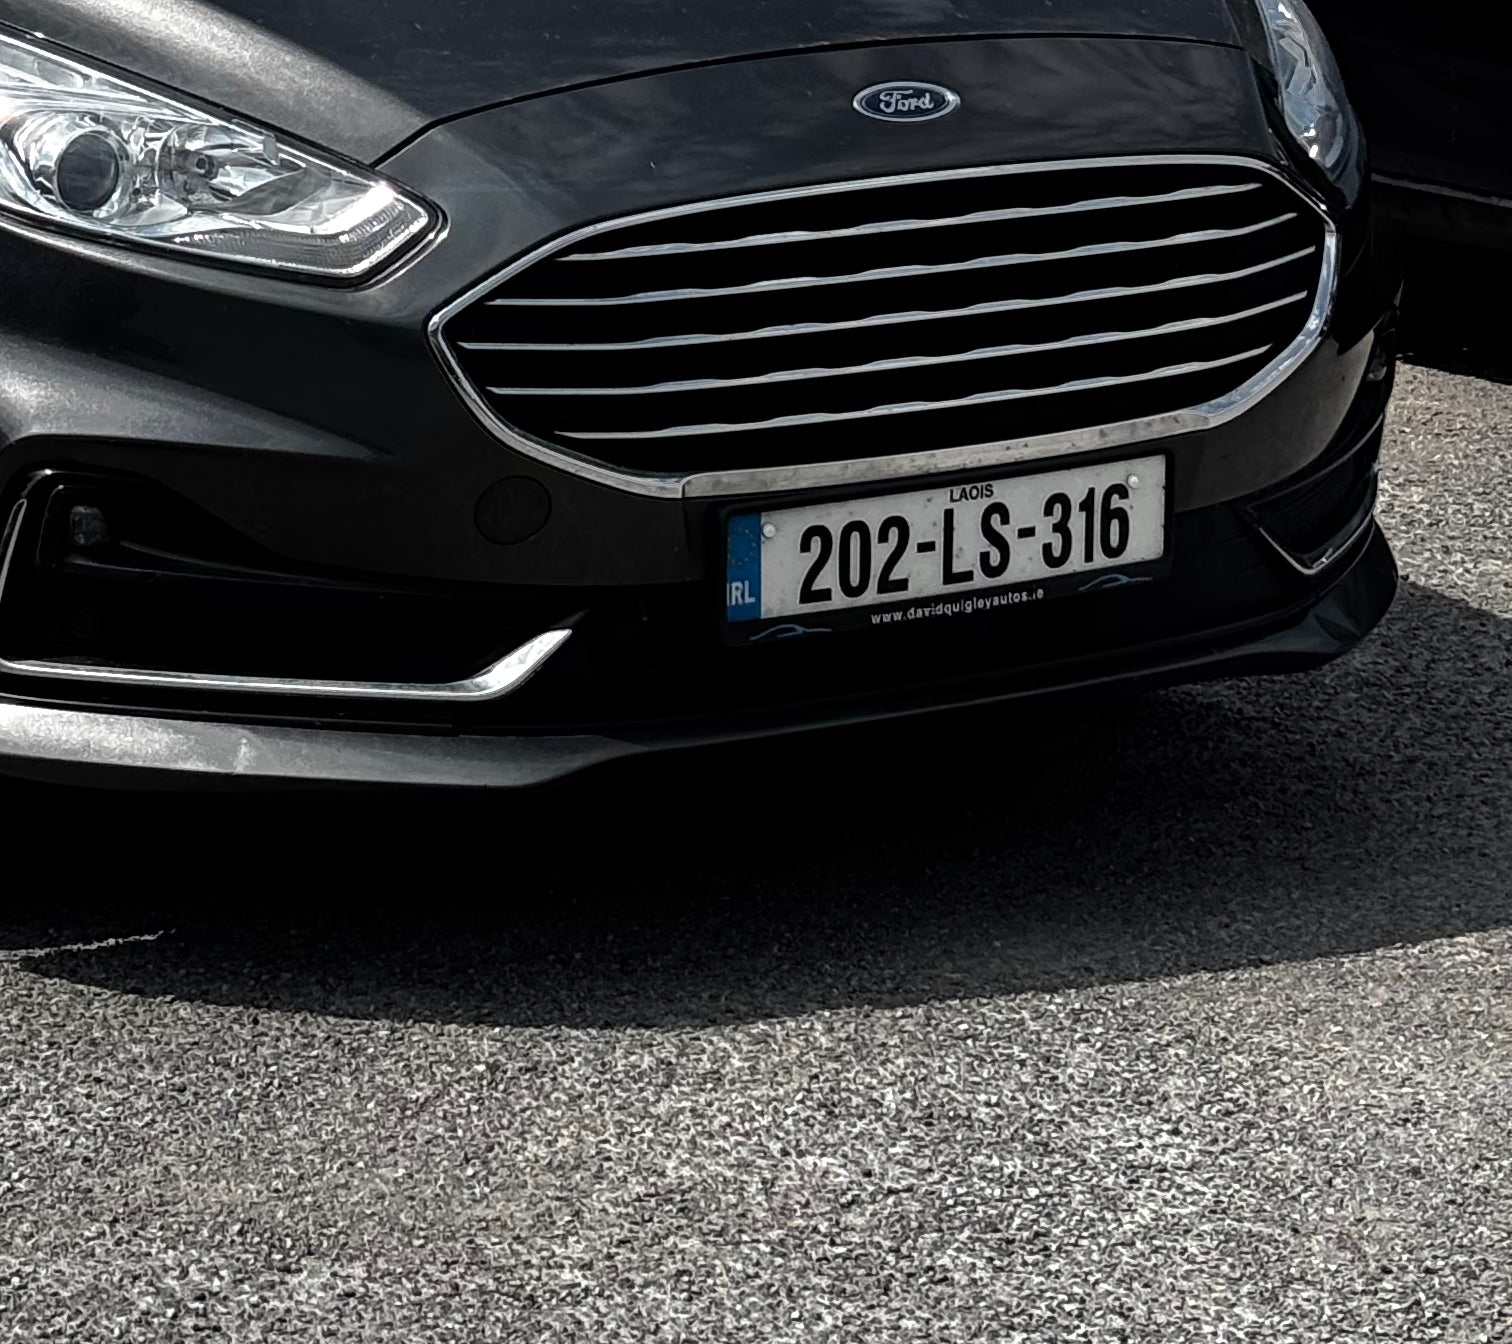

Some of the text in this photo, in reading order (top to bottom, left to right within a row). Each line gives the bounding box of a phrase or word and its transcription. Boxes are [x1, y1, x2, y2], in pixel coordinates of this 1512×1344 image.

[879, 89, 935, 114] Ford
[949, 483, 994, 503] LAOIS
[799, 483, 1130, 605] 202-LS-316
[726, 581, 756, 607] IRL
[870, 589, 1044, 625] www.davidquigleyautos.ie
